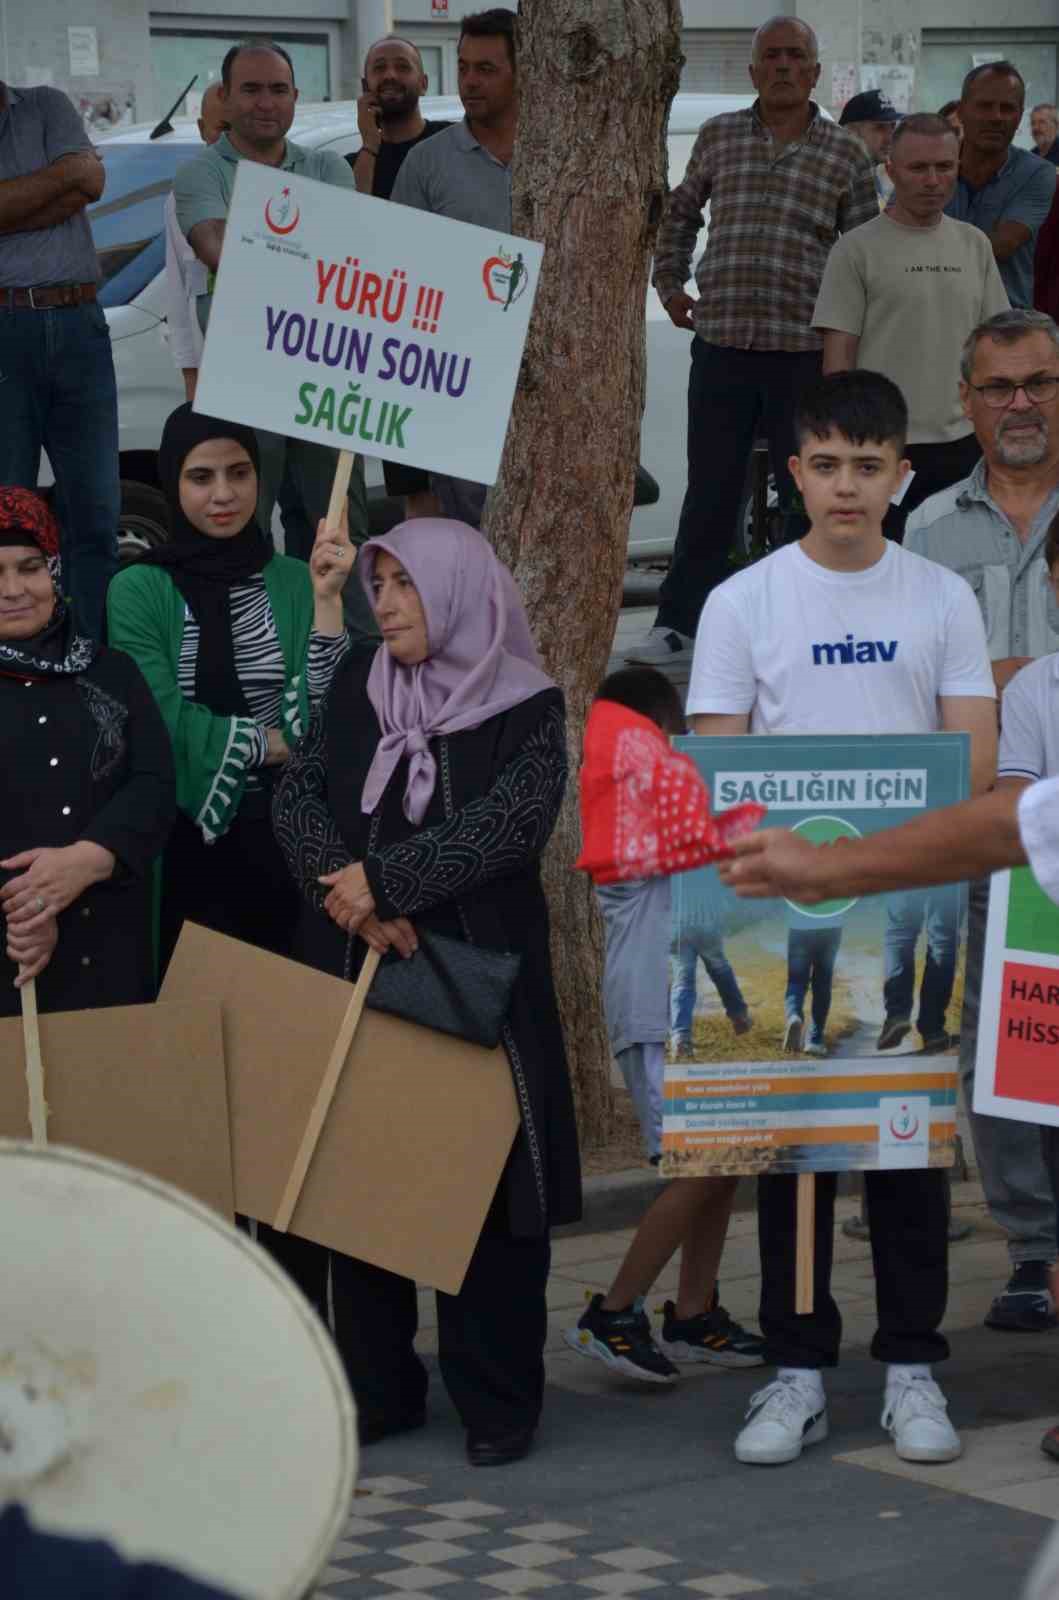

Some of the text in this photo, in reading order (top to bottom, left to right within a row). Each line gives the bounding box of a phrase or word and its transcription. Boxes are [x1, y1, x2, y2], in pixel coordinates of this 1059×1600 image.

[316, 257, 408, 323] YÜRÜ
[266, 306, 471, 398] YOLUN SONU
[294, 381, 413, 449] SAĞLIK
[811, 634, 898, 665] miav
[720, 772, 922, 807] SAĞLIĞIN İÇİN
